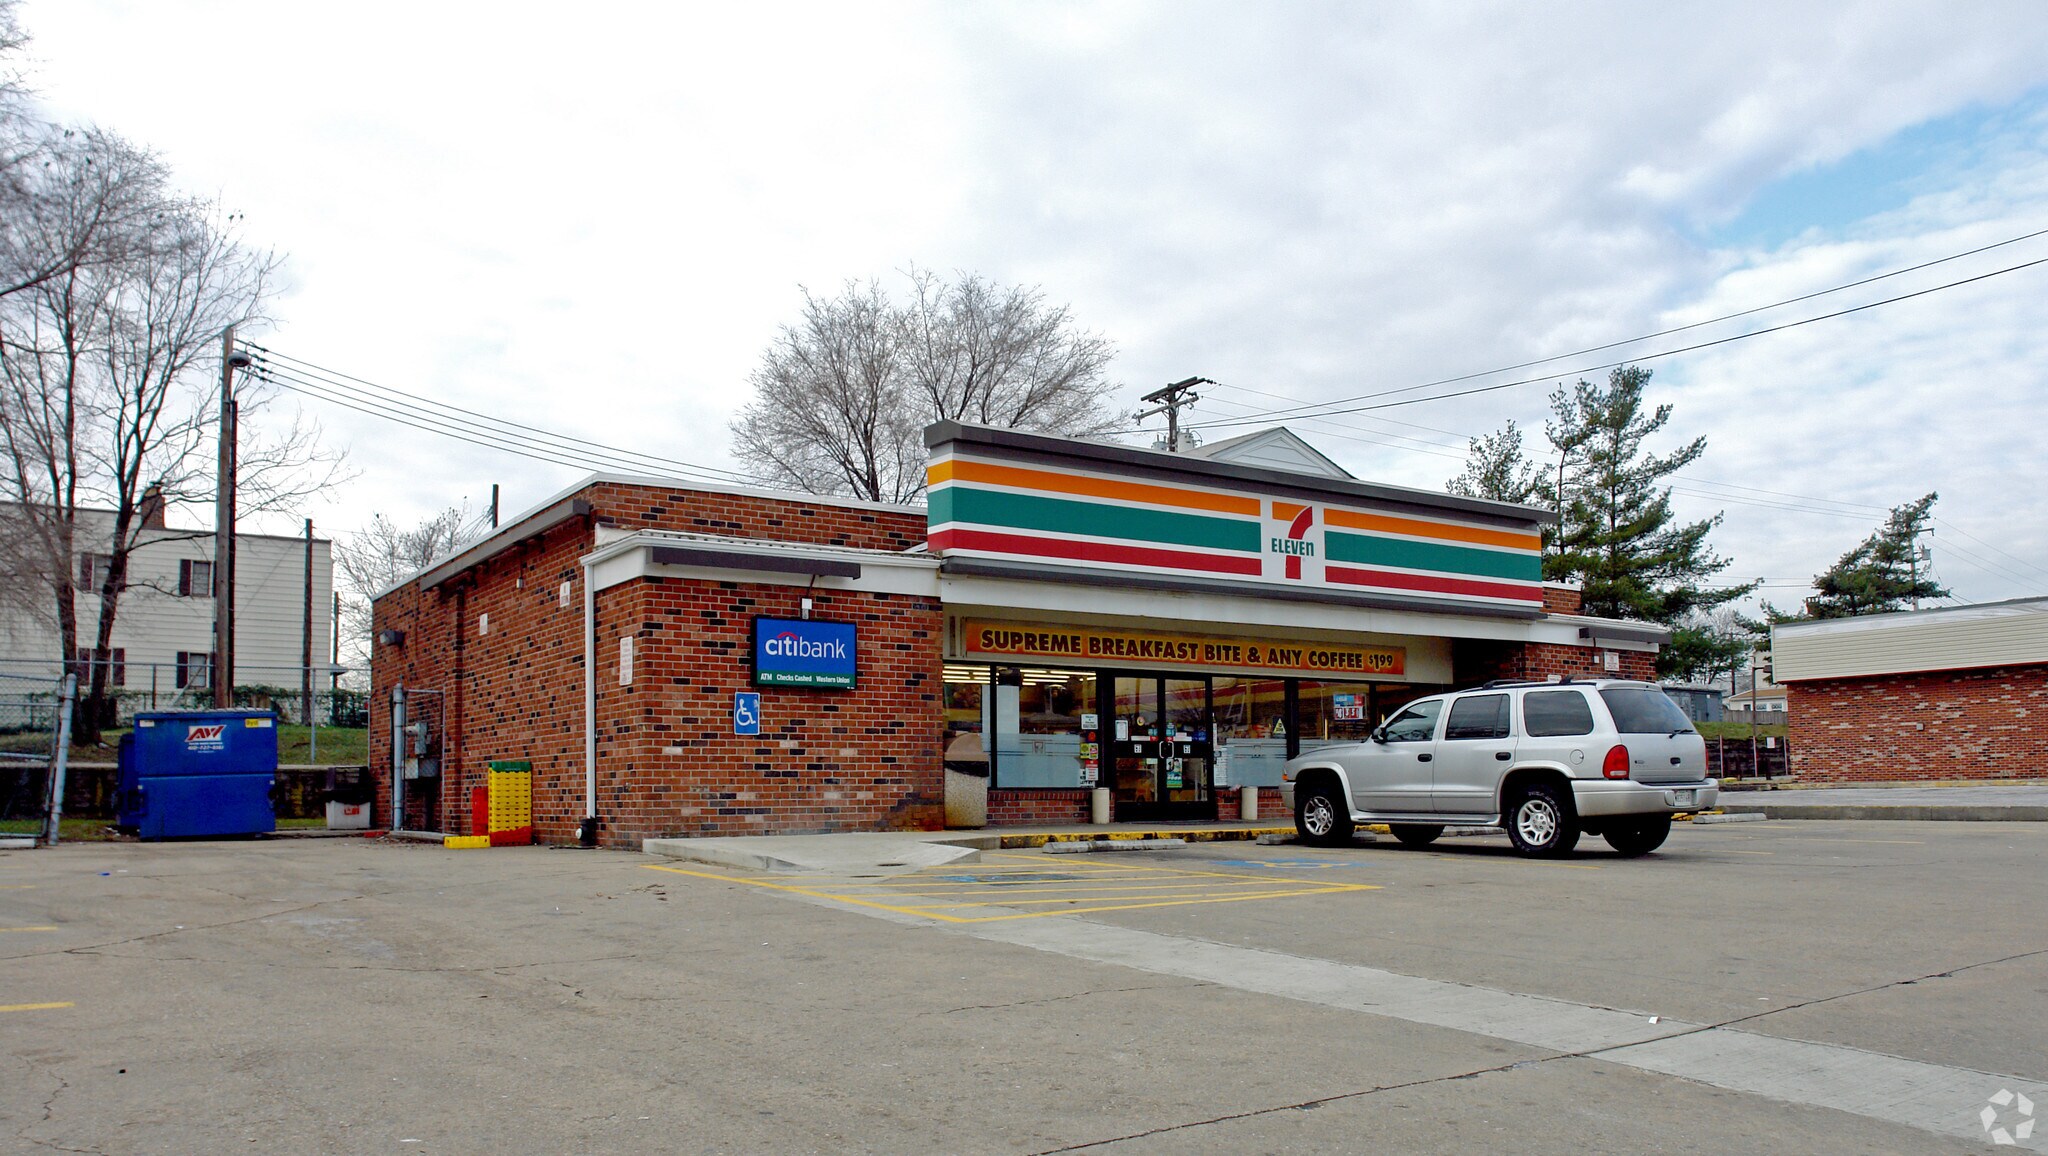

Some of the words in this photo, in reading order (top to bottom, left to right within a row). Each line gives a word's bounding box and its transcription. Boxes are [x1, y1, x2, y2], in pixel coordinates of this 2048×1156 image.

[1285, 506, 1313, 580] 7
[765, 635, 846, 659] citibank
[981, 629, 1081, 653] SUPREME
[1088, 636, 1199, 660] BREAKFAST
[1204, 643, 1241, 662] BITE
[1247, 646, 1262, 663] &
[1267, 648, 1303, 665] ANY
[1308, 651, 1363, 669] COFFEE
[760, 673, 773, 681] ATM
[776, 673, 794, 682] Checks
[794, 674, 812, 682] Cashed
[816, 675, 836, 683] Western
[836, 676, 850, 684] Union
